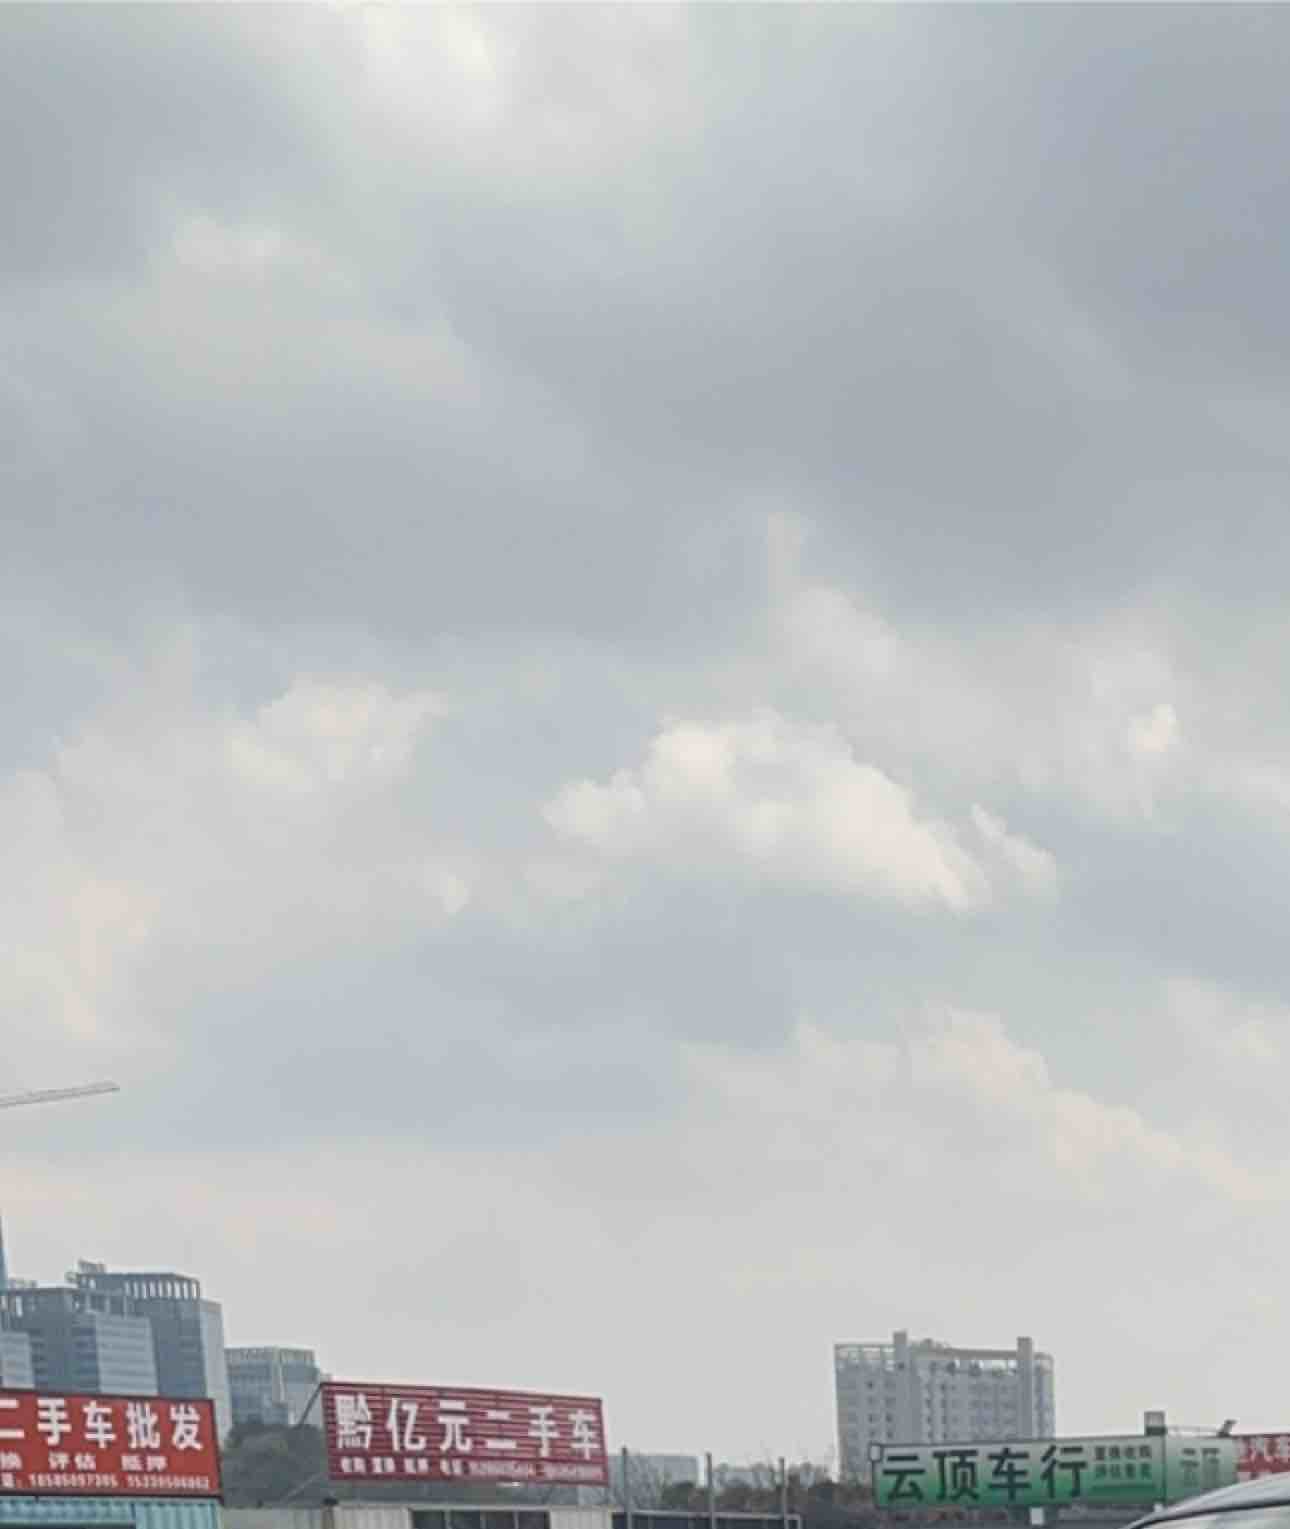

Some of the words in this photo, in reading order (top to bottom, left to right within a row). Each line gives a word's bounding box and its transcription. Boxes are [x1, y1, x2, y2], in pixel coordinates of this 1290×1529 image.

[0, 1398, 202, 1450] 二手车批发
[334, 1393, 599, 1461] 黔亿元二手车
[882, 1445, 1086, 1501] 云顶车行
